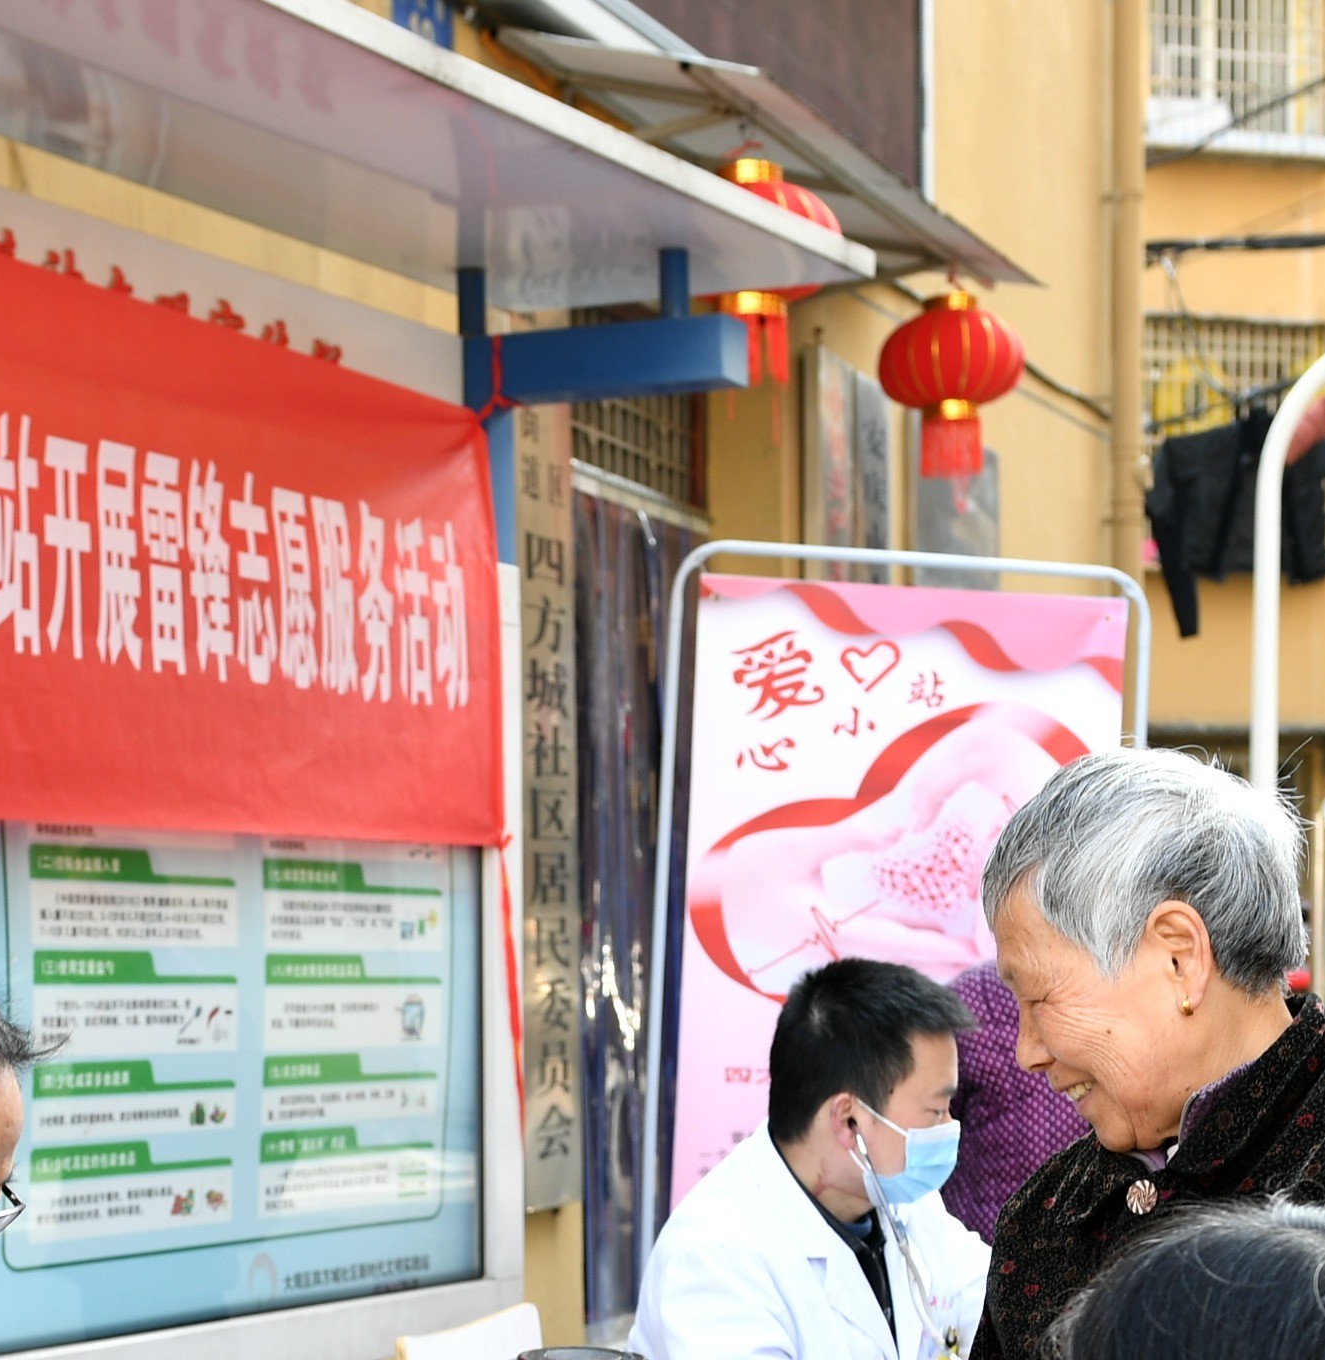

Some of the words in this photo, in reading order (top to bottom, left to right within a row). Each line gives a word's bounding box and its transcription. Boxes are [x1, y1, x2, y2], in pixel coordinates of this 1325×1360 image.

[524, 532, 574, 1162] 四方城社区居民委员会
